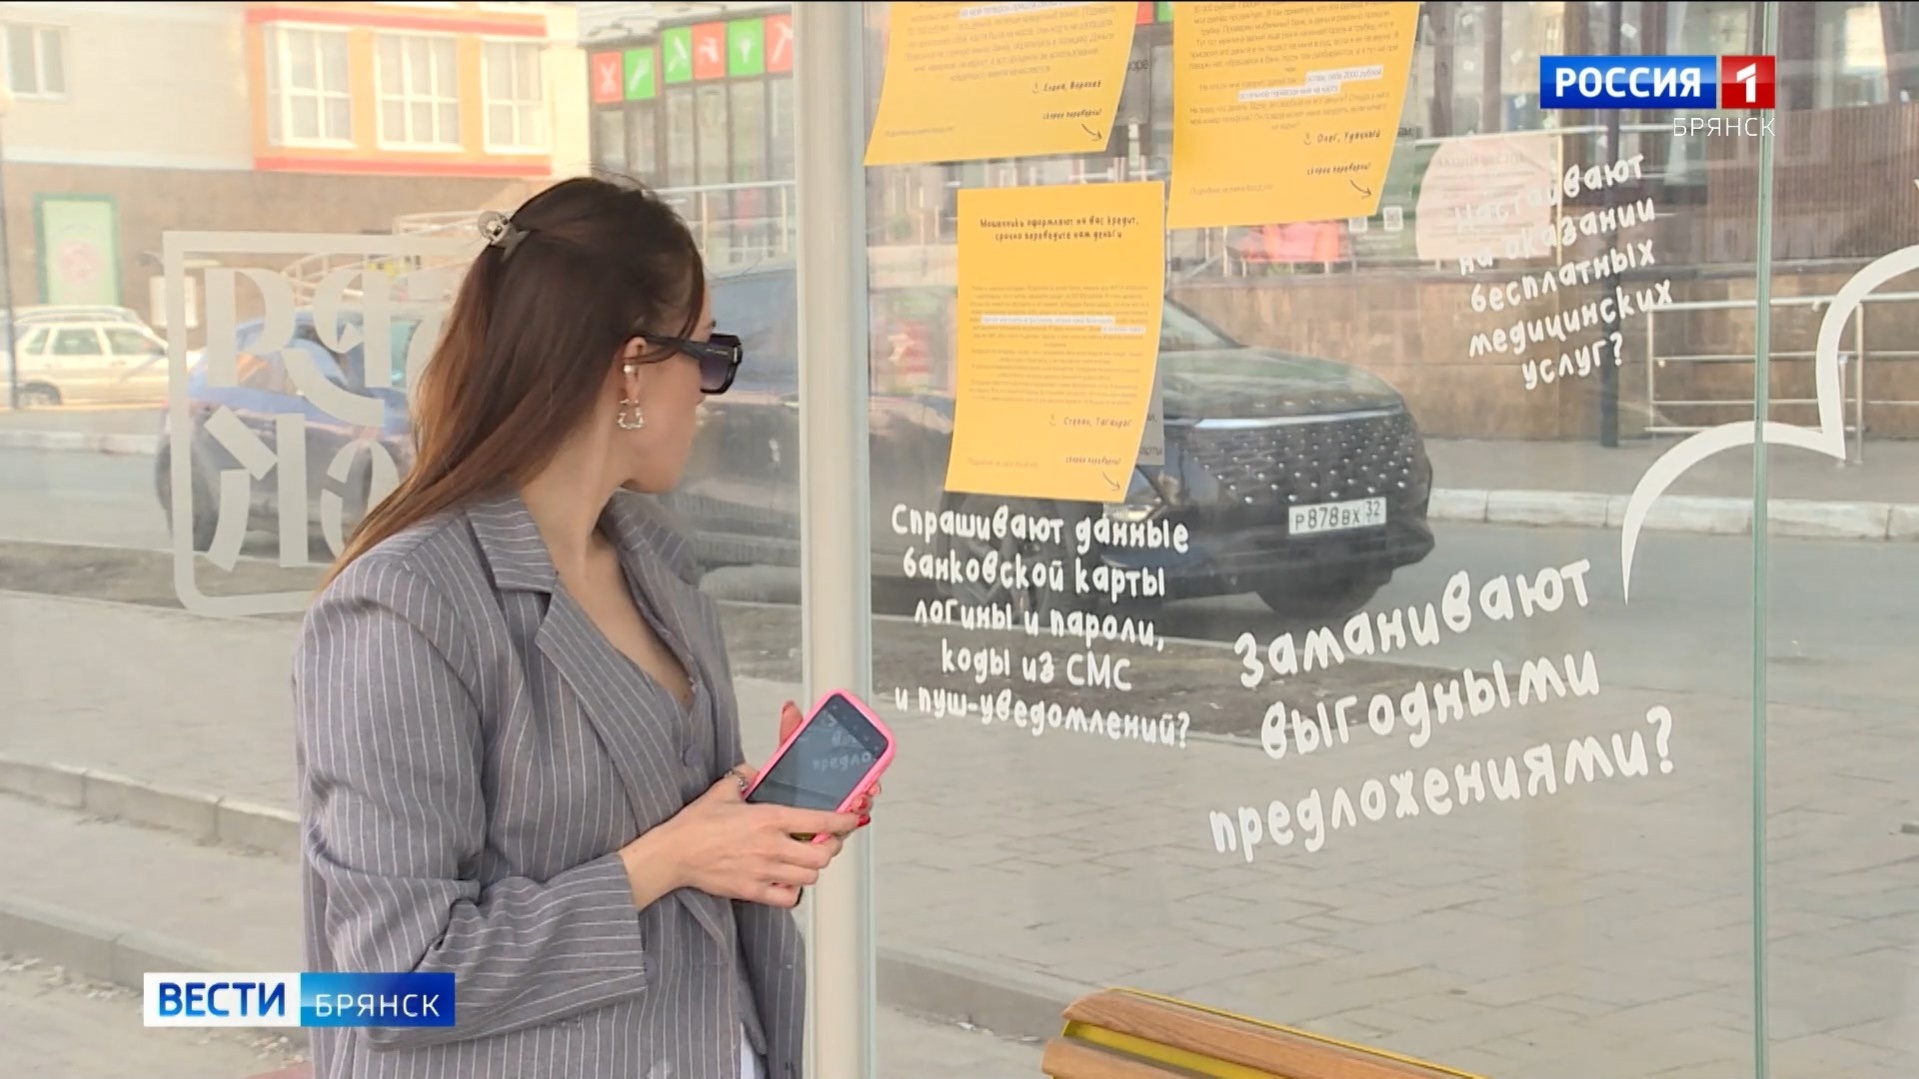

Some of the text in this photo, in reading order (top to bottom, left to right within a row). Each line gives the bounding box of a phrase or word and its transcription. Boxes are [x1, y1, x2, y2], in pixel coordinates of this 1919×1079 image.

[1502, 197, 1656, 259] оказании
[1470, 239, 1656, 313] бесплатных
[1469, 279, 1673, 359] медицинских
[1521, 331, 1623, 391] услуг?
[892, 504, 1189, 554] Спрашивают данные
[1295, 500, 1381, 531] Р878ВХ 32
[902, 546, 1166, 603] банковской карты
[914, 599, 1165, 651] логины и пароли,
[1233, 558, 1591, 688] Заманивают
[941, 638, 1133, 691] коды из СМС
[895, 686, 1191, 749] и пуш-уведомлений?
[1261, 650, 1601, 760] выгодными
[1208, 704, 1675, 864] предложениями?
